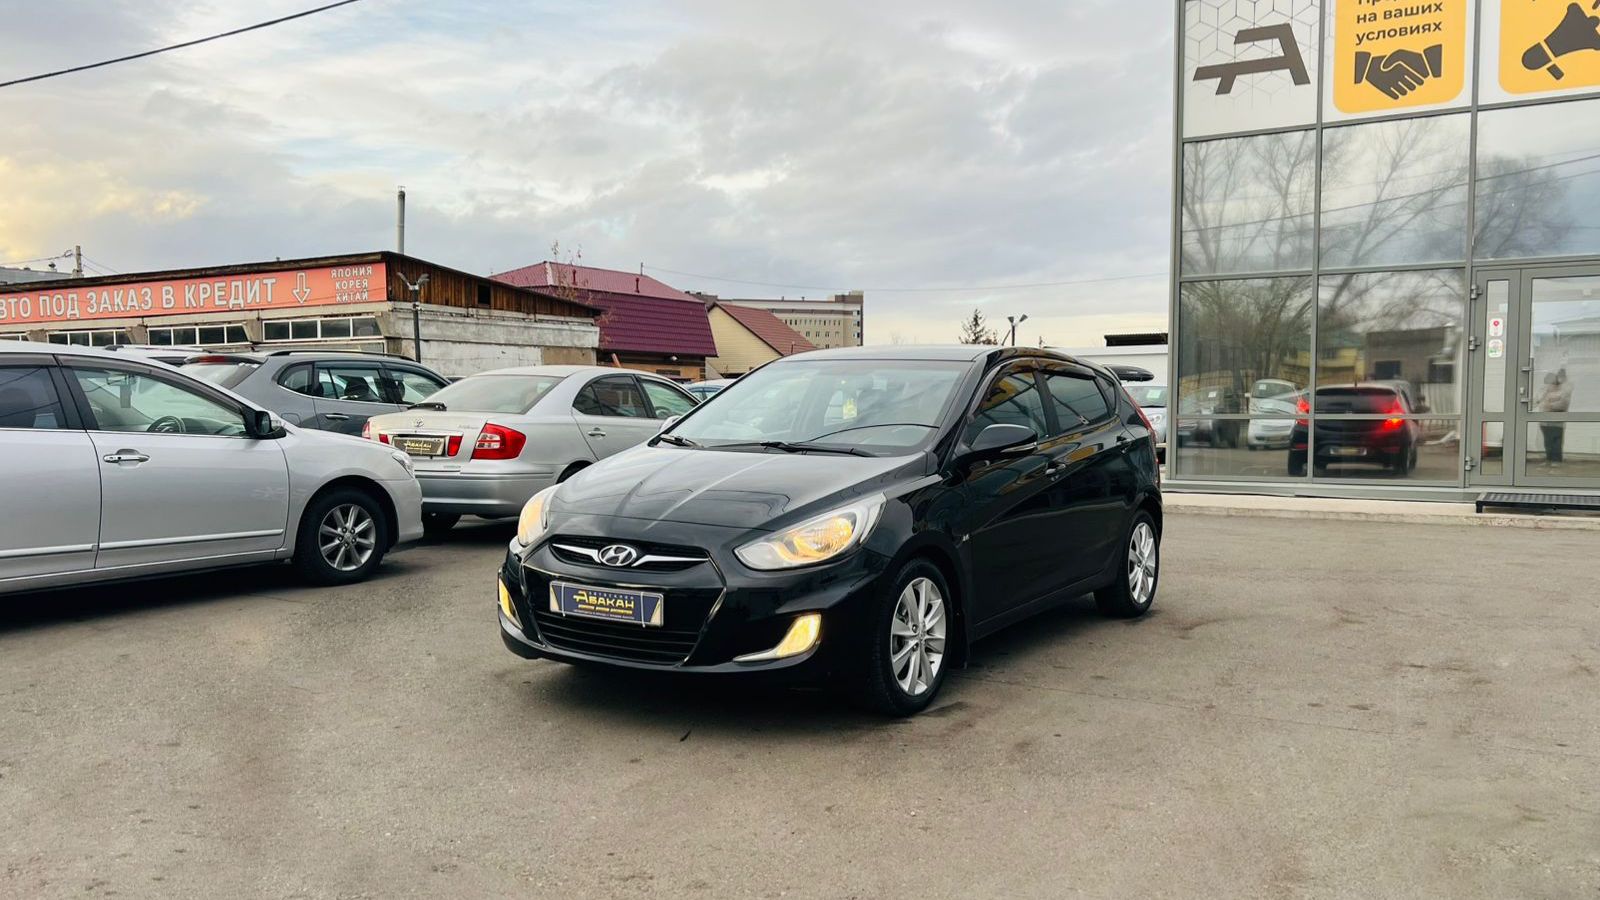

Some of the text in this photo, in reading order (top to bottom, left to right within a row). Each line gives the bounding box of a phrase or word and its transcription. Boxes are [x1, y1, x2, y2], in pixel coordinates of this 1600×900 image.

[1357, 2, 1443, 24] на ваших
[1356, 21, 1442, 46] условиях
[331, 266, 372, 279] ЯПОНИЯ
[335, 279, 368, 290] КОРЕЯ
[39, 293, 80, 319] ПОД
[87, 286, 152, 314] ЗАКАЗ
[162, 285, 175, 309] В
[184, 278, 276, 310] КРЕДИТ
[336, 289, 369, 302] КИТАЙ
